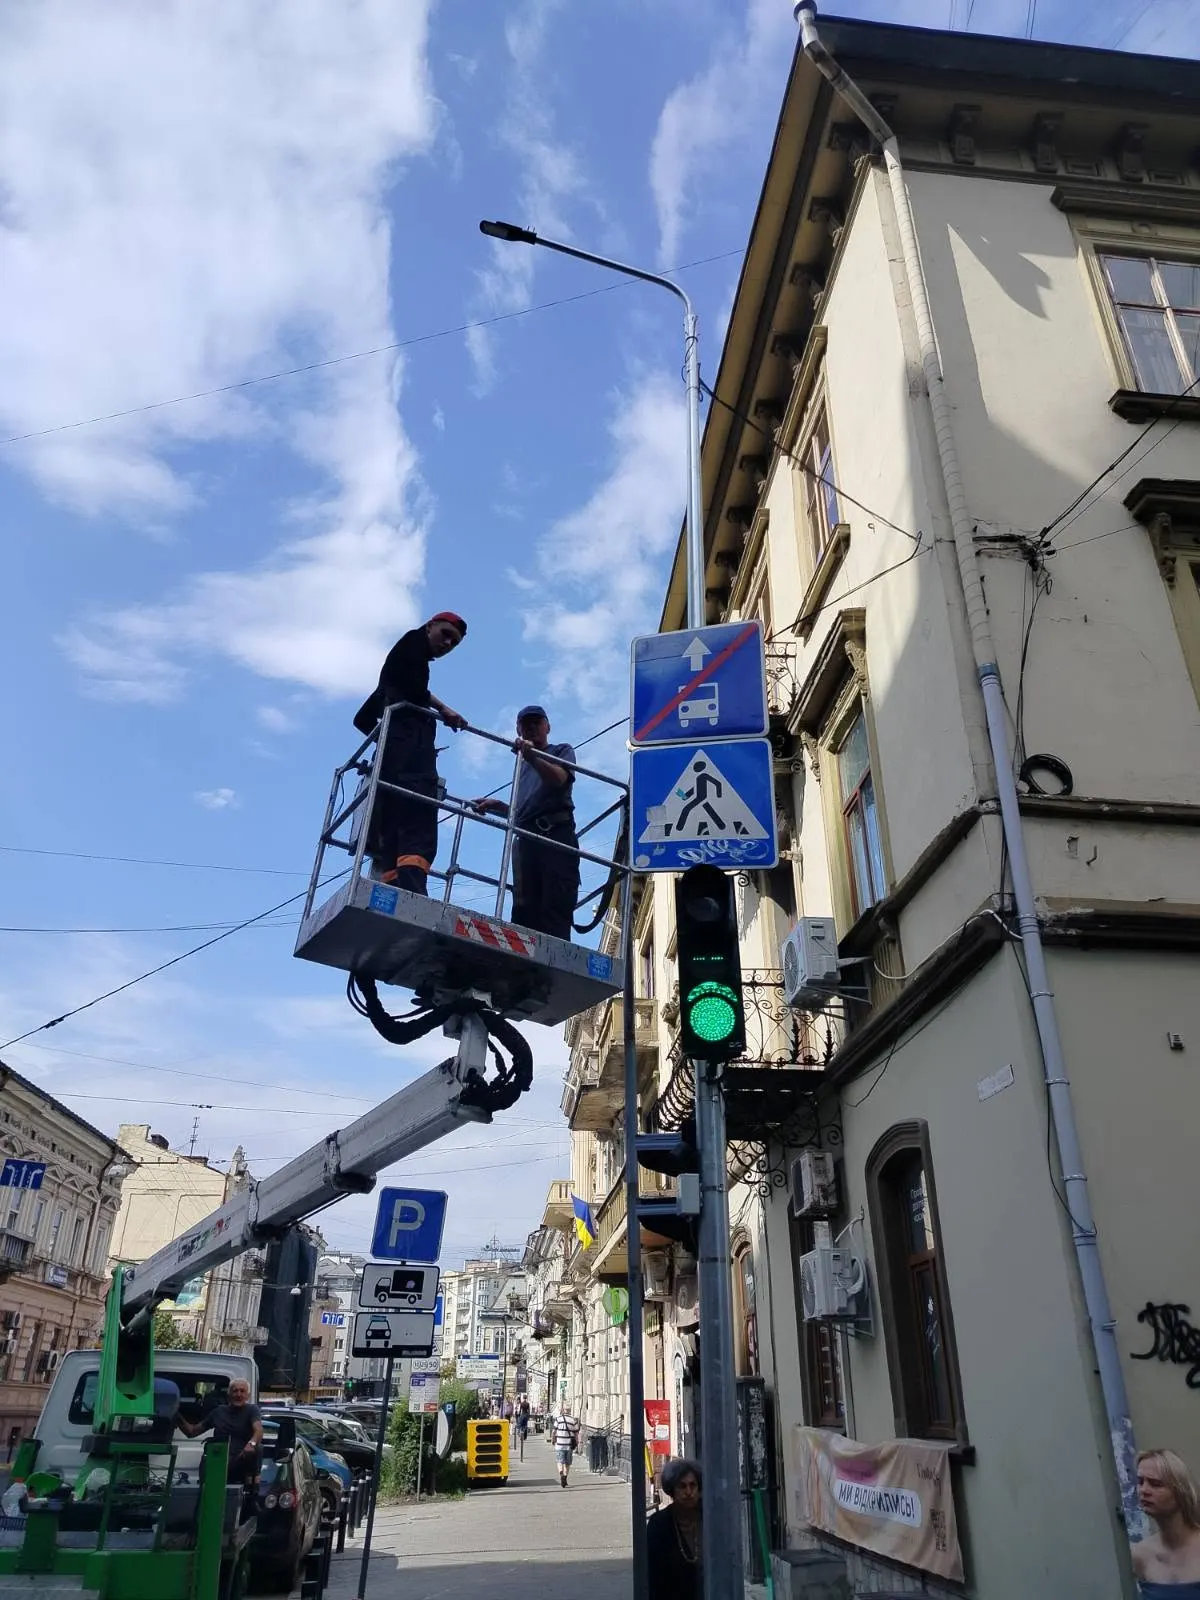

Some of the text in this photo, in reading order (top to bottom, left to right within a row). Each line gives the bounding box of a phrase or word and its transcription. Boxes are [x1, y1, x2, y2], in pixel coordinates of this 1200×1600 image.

[388, 1199, 425, 1248] P
[446, 1403, 453, 1413] P
[838, 1483, 915, 1519] МИ ВІДКРИЛИСЬ!
